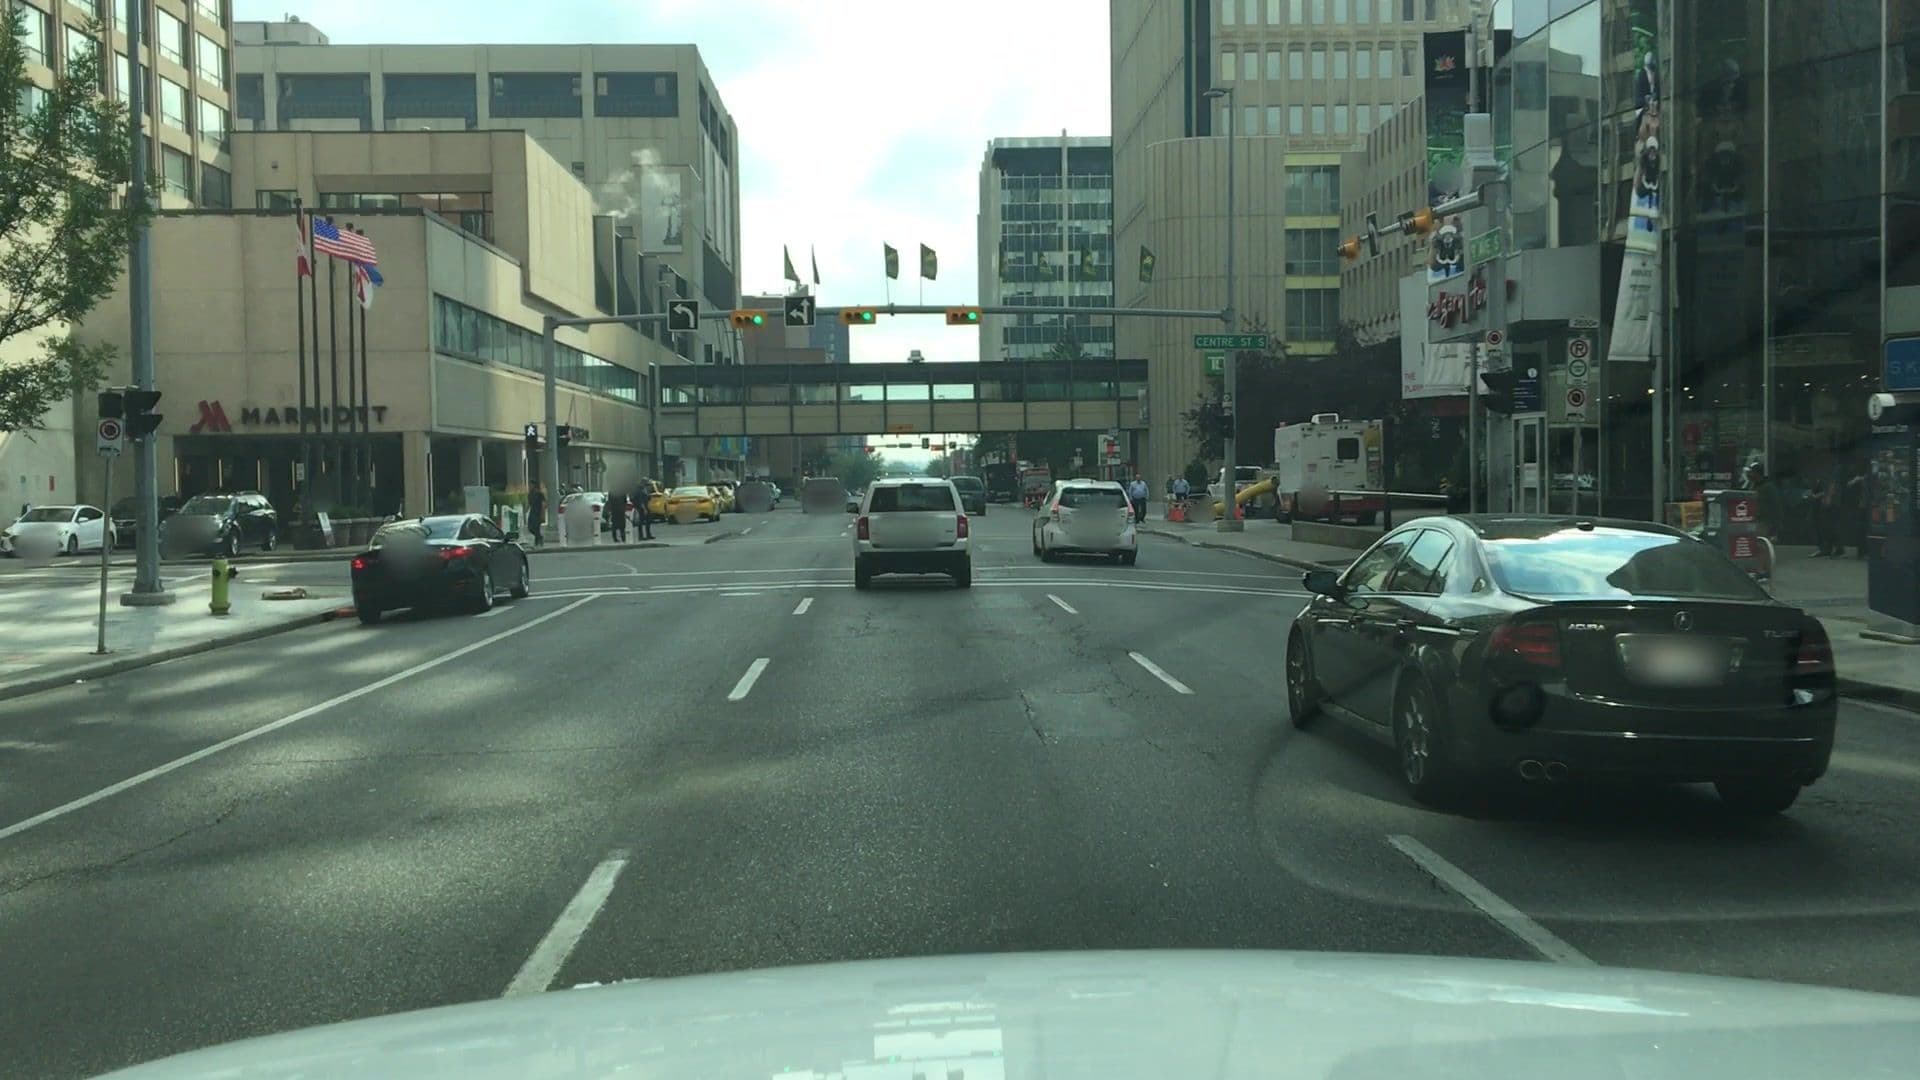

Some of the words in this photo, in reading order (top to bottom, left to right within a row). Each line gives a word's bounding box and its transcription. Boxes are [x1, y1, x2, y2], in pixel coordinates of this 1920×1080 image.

[1196, 337, 1234, 347] CENTRE
[1240, 337, 1251, 347] ST
[1259, 337, 1265, 347] S
[241, 406, 387, 425] MARRIOTT
[1568, 623, 1605, 632] ACURA
